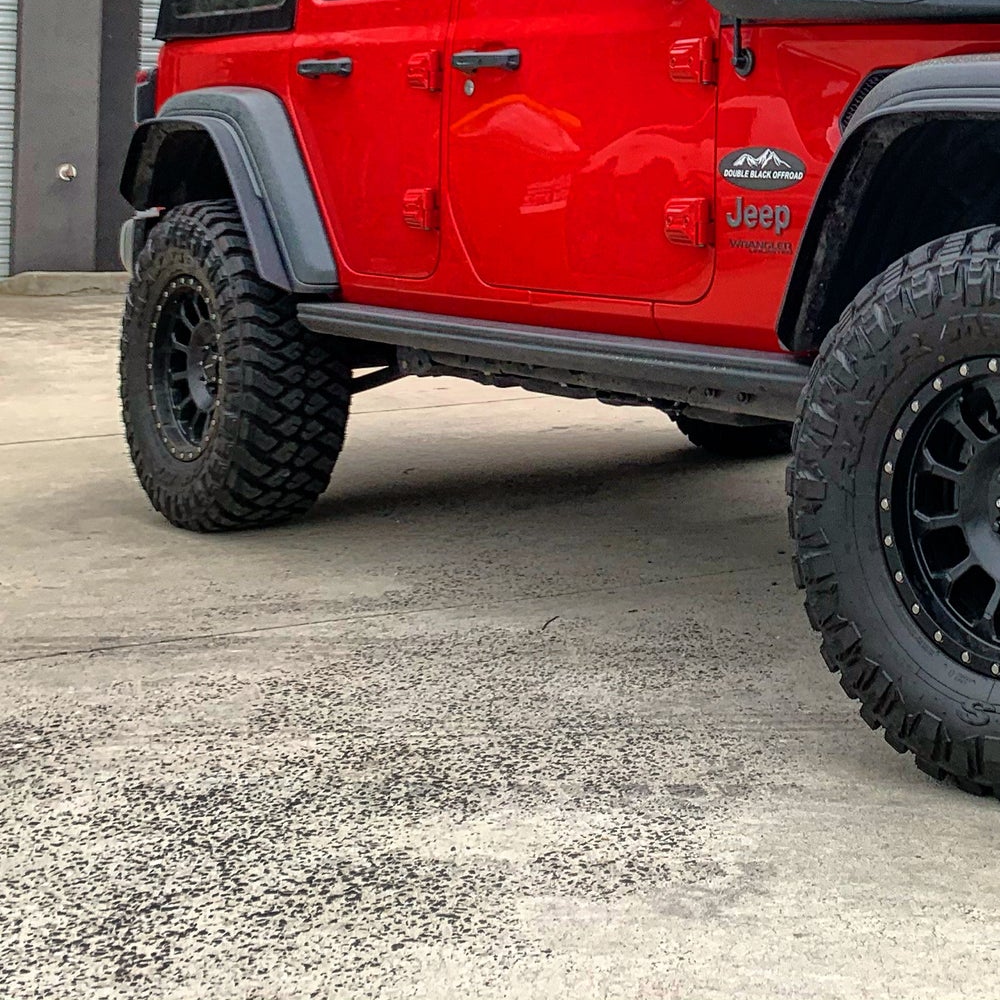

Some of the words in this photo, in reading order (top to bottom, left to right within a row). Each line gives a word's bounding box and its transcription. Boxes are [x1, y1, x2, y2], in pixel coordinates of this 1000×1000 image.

[723, 169, 750, 178] DOUBLE
[750, 170, 772, 179] BLACK
[772, 171, 804, 180] OFFROAD
[726, 196, 791, 235] Jeep
[730, 239, 793, 250] WRANGLER
